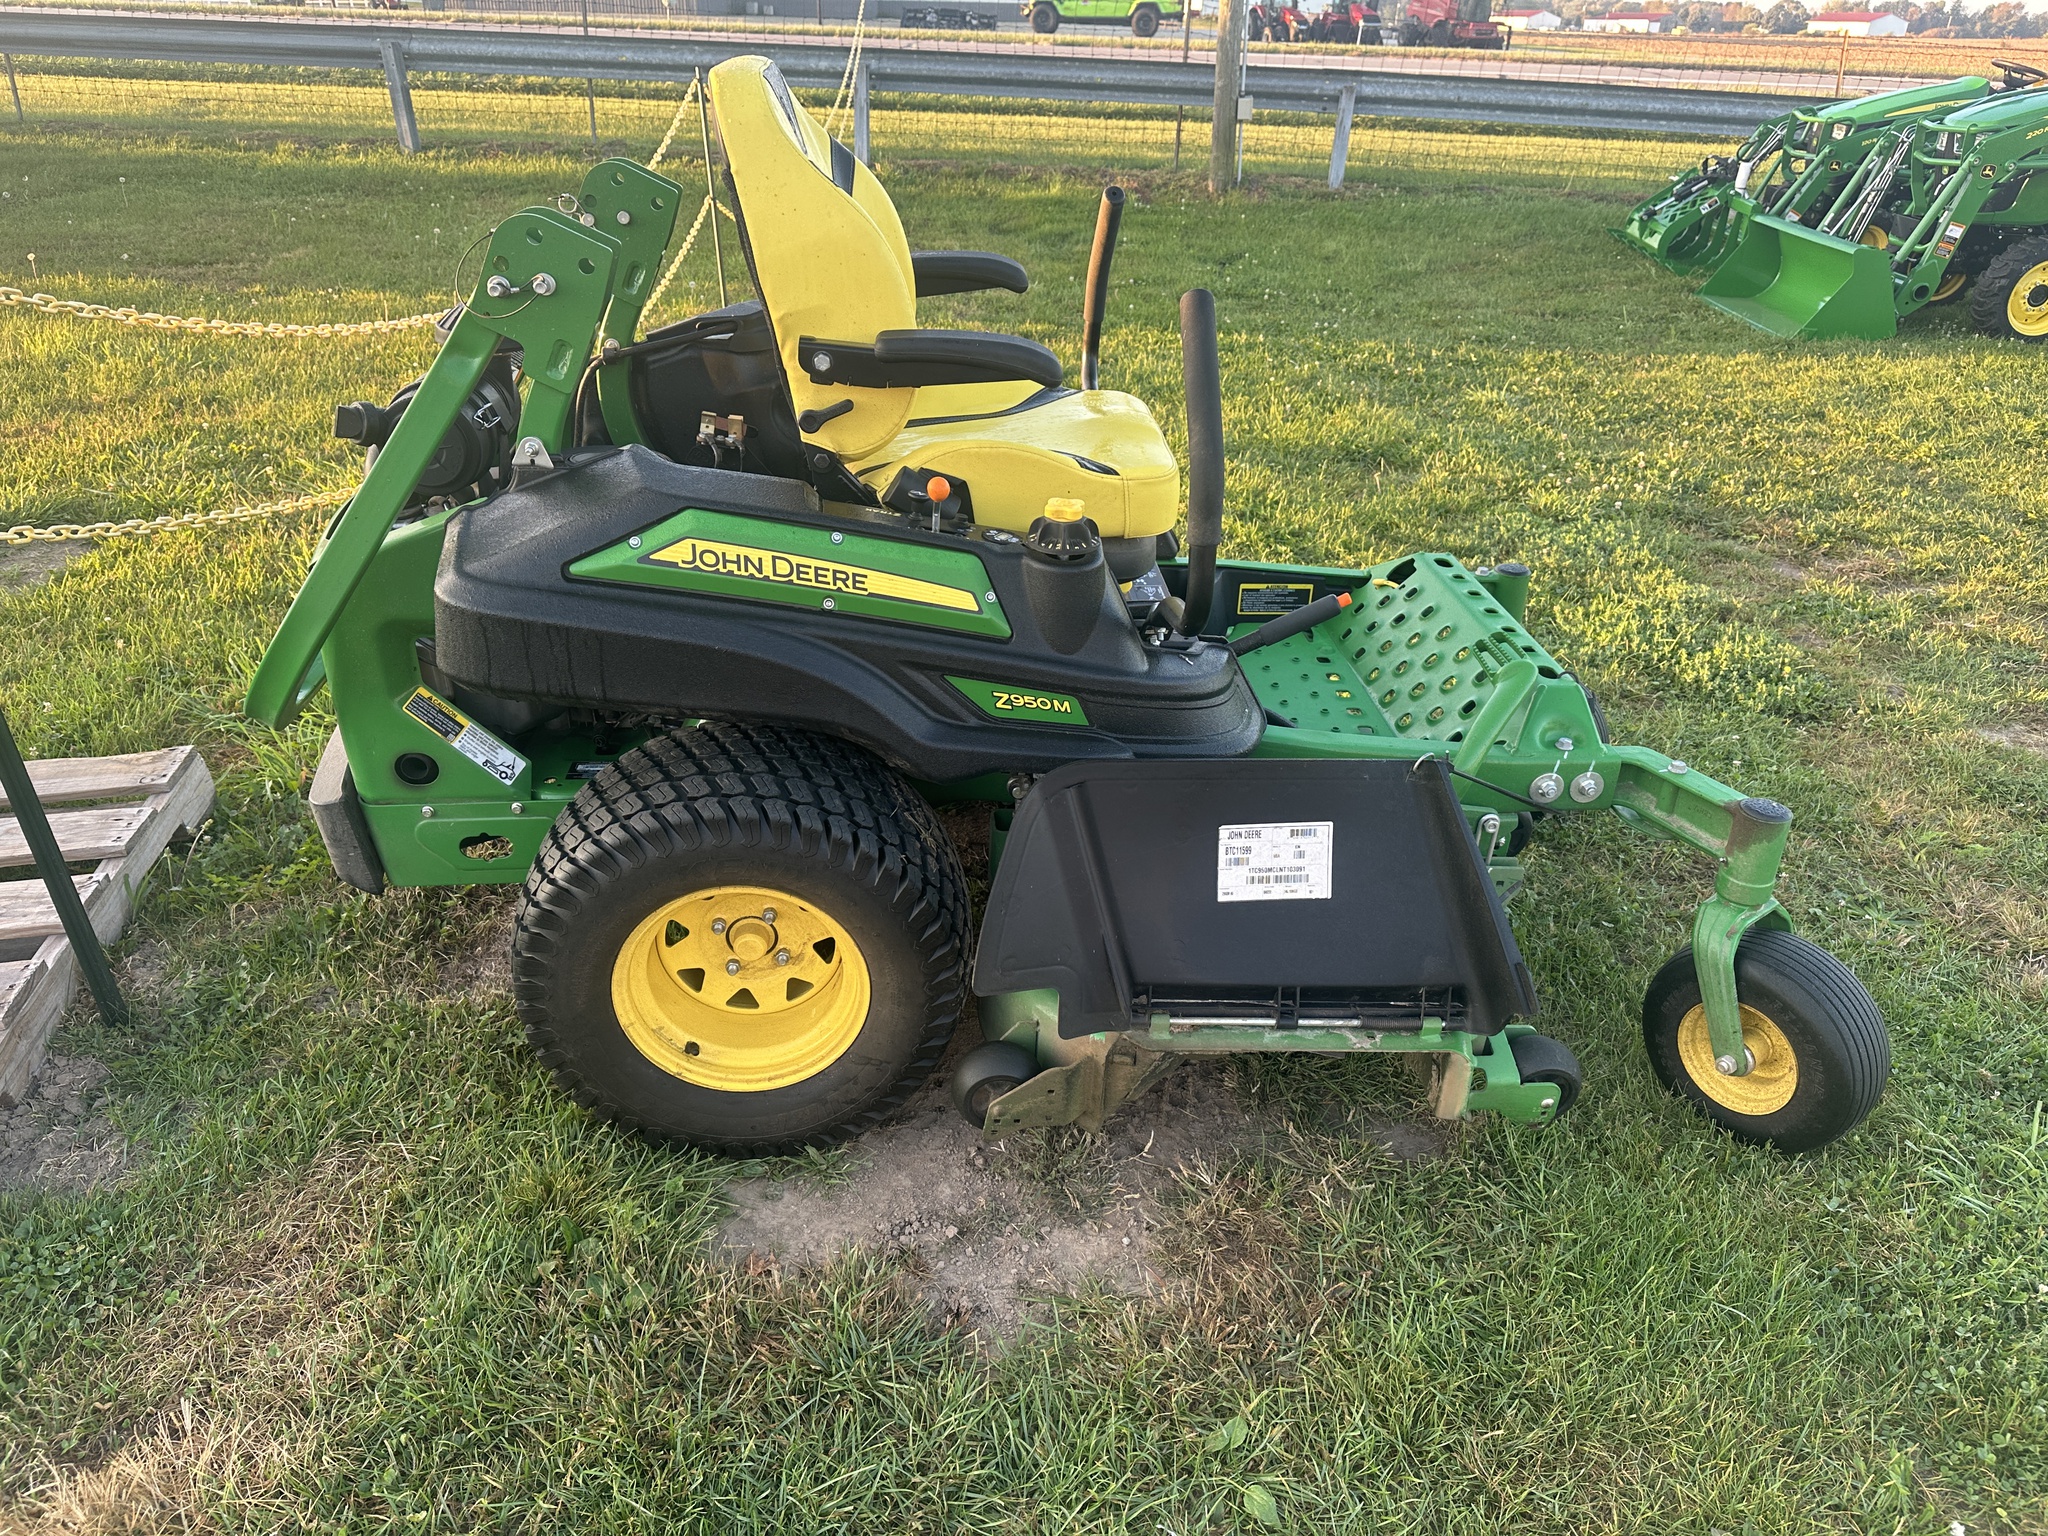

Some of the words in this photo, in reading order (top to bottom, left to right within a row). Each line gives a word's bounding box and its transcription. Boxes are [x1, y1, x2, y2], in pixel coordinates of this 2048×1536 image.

[681, 543, 763, 575] JOHN
[771, 555, 868, 592] DEERE
[433, 697, 458, 719] CAUTION
[1227, 830, 1243, 840] JOHN
[1244, 830, 1262, 840] DEERE
[1225, 846, 1252, 856] BTC11599
